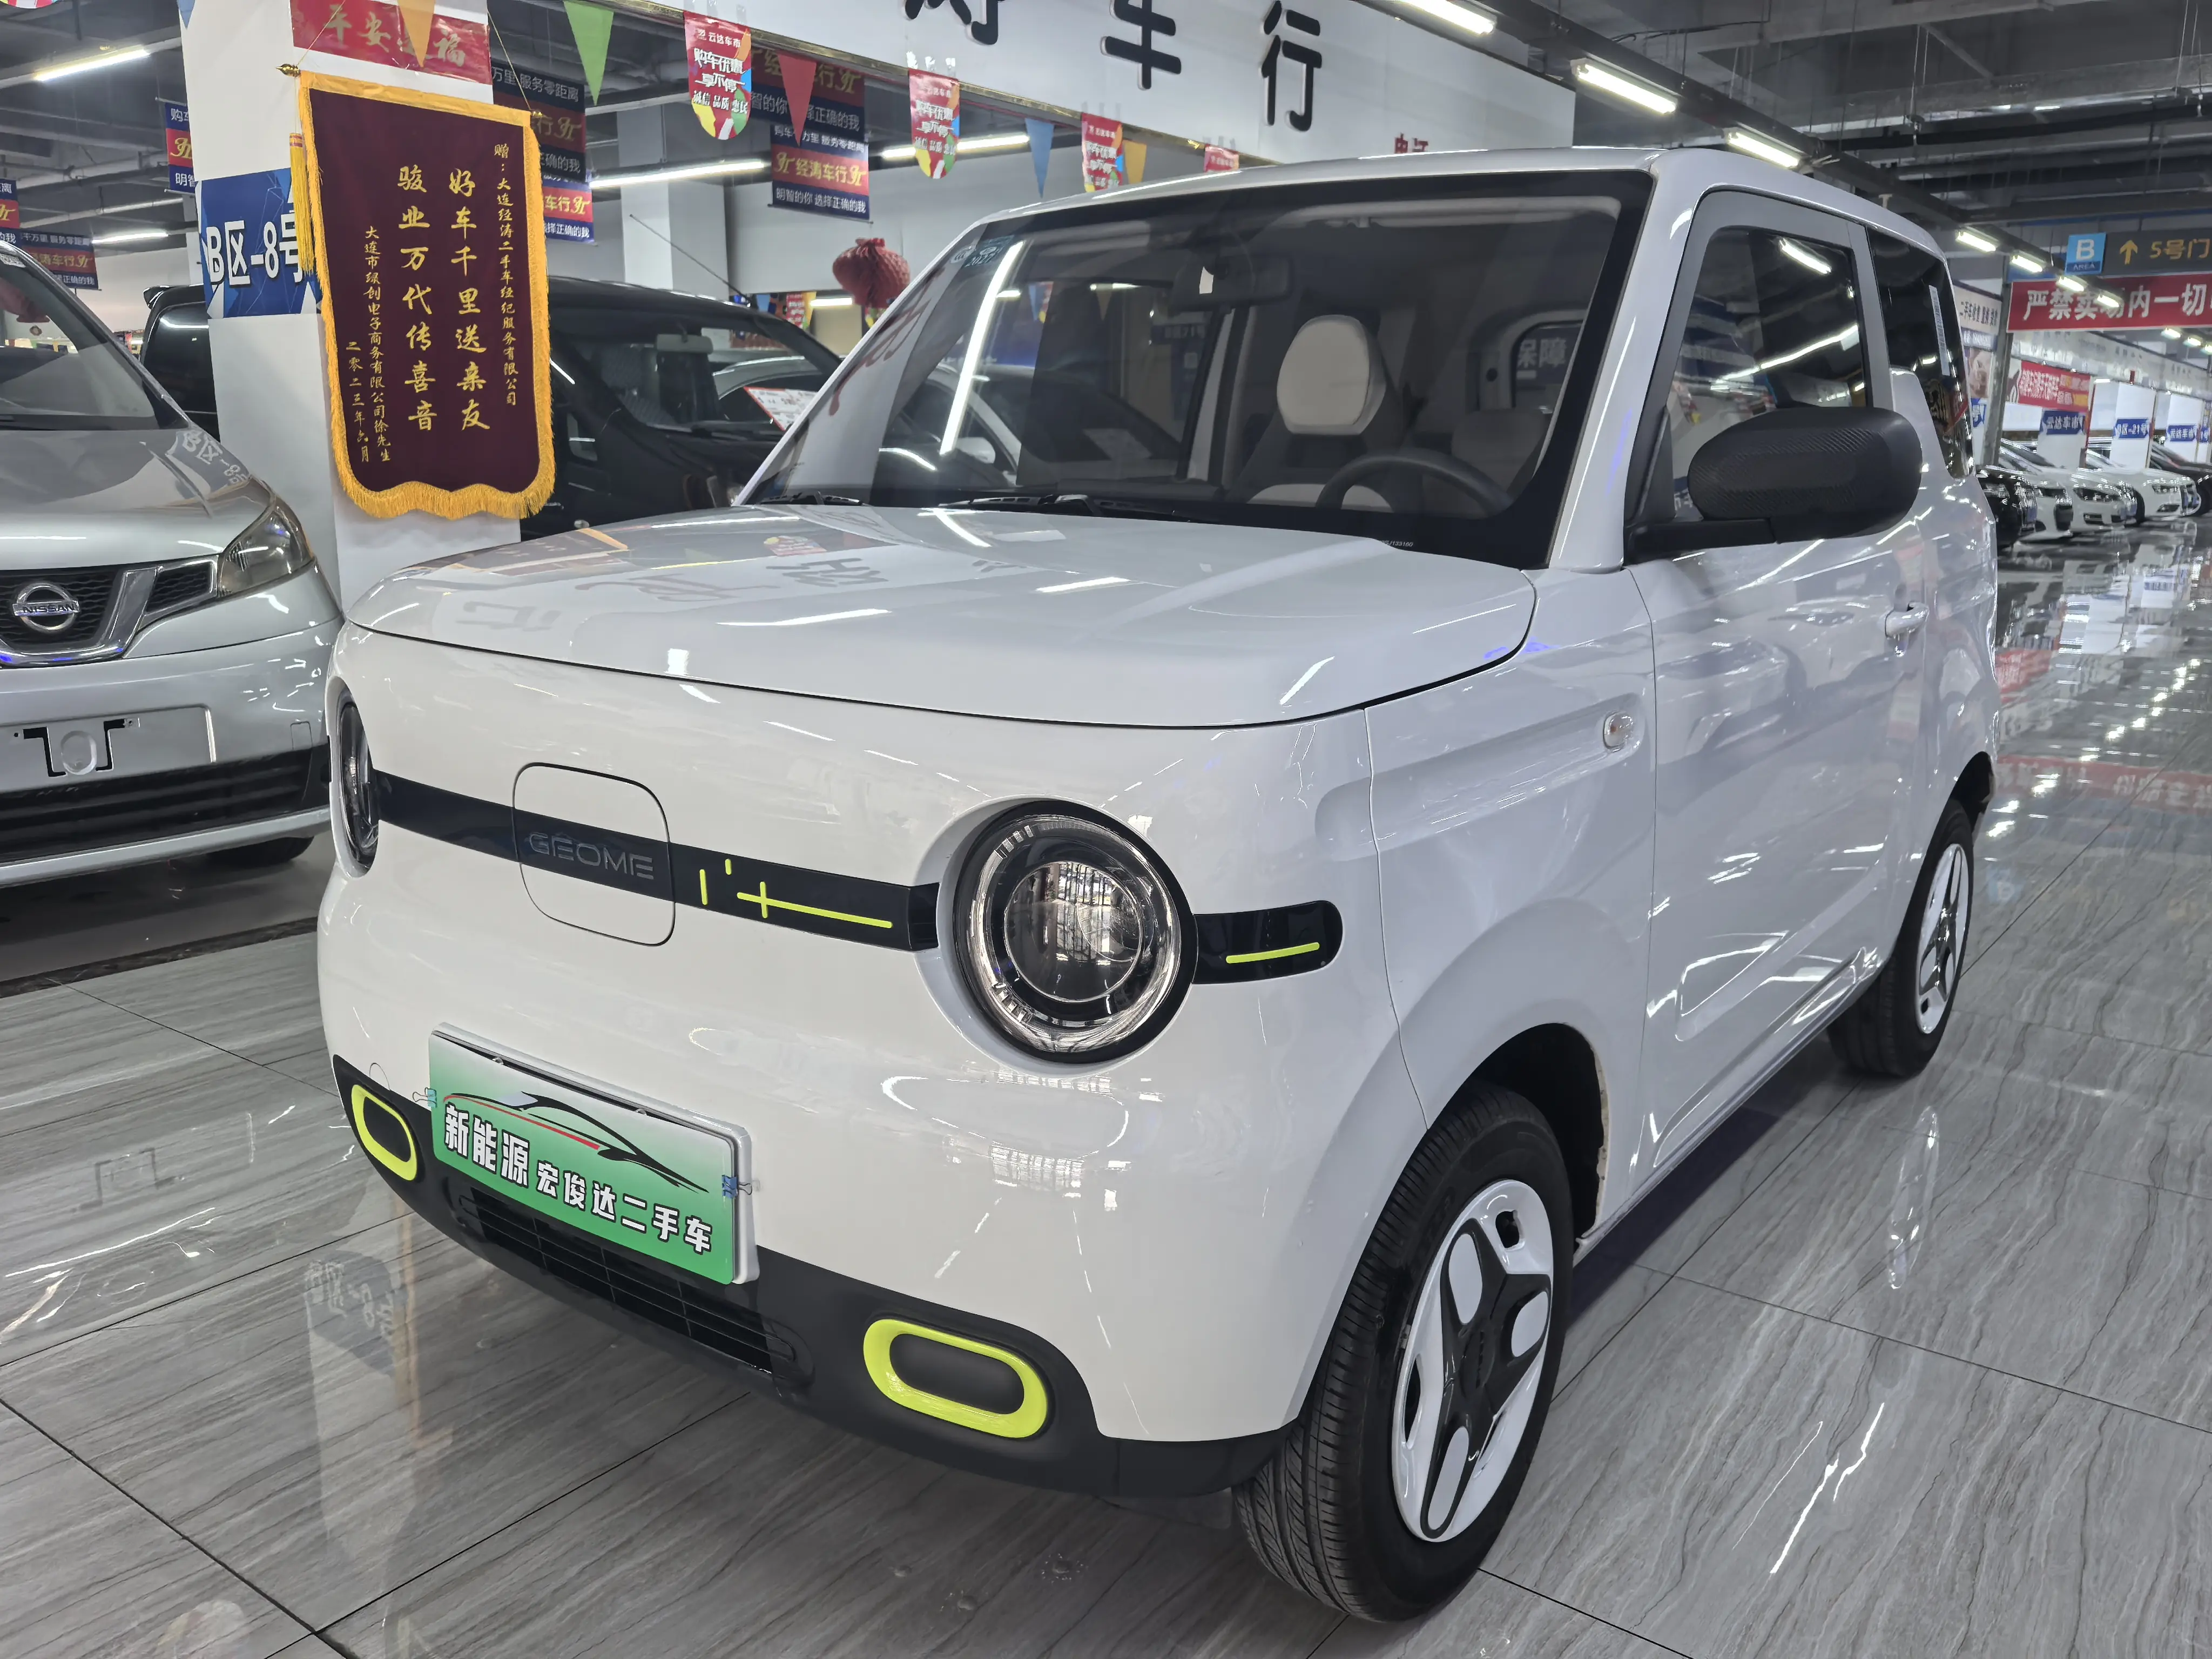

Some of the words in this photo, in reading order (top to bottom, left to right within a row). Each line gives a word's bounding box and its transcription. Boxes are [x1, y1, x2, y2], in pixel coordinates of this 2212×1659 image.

[774, 125, 819, 144] 购车万里
[544, 194, 570, 212] 车行
[544, 221, 590, 239] 择正确的我
[2076, 239, 2095, 260] B
[2149, 238, 2210, 259] 5号门
[397, 164, 437, 431] 骏业万代传喜音
[449, 168, 490, 431] 好车千里送亲友
[2023, 282, 2212, 321] 严禁卖内一切
[23, 604, 75, 613] NISSAN
[529, 832, 654, 880] GEOME
[443, 1103, 530, 1188] 新能源
[536, 1159, 713, 1254] 宏俊达二手车
